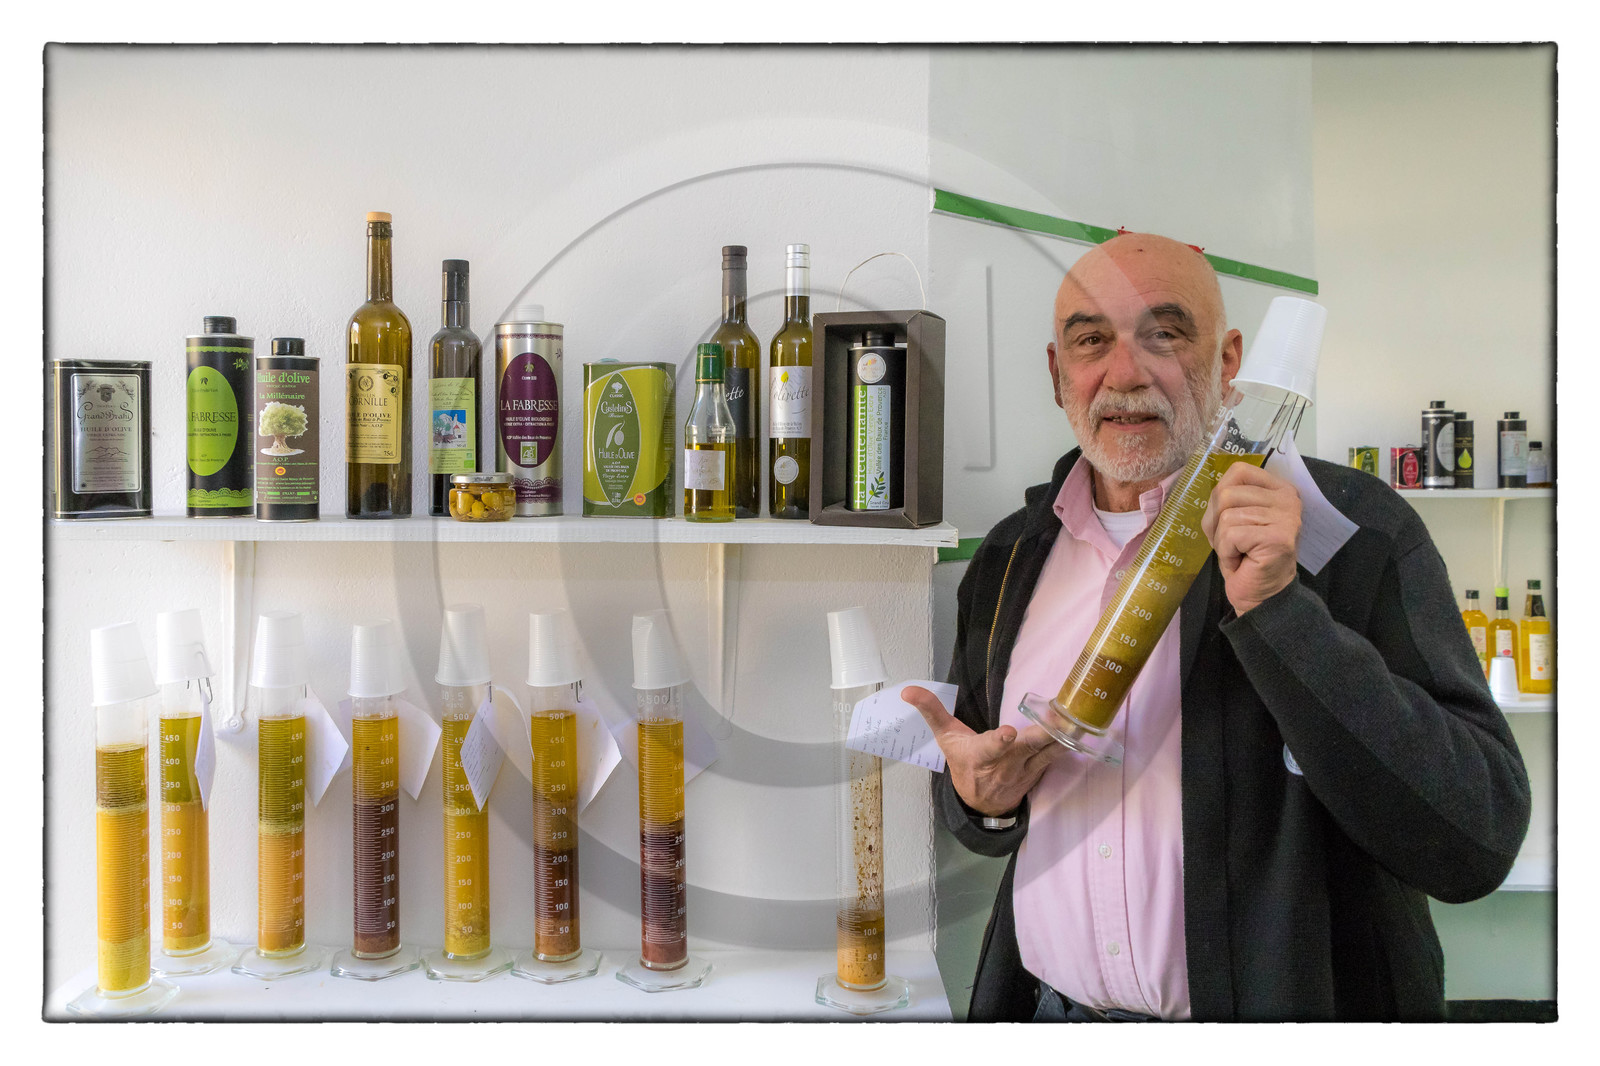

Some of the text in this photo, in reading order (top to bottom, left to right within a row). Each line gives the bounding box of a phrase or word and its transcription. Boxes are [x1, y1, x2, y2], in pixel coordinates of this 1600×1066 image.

[278, 372, 310, 384] d'olive
[266, 392, 305, 400] Millénaire
[500, 399, 558, 412] LA FABRESSE
[191, 411, 237, 423] FABRESSE
[854, 390, 866, 504] la lieutenante
[1224, 440, 1246, 457] 500
[1208, 469, 1224, 482] 45
[1193, 497, 1208, 509] 40
[1177, 524, 1199, 540] 350
[1162, 551, 1183, 567] 300
[1146, 579, 1168, 595] 250
[1132, 605, 1153, 621] 200
[1119, 633, 1138, 647] 150
[1104, 659, 1123, 674] 100
[1093, 687, 1108, 700] 50
[291, 732, 303, 740] 450
[291, 756, 303, 764] 400
[291, 779, 303, 787] 350
[381, 780, 394, 788] 350
[291, 802, 303, 811] 300
[381, 803, 394, 812] 300
[381, 827, 395, 836] 250
[381, 850, 395, 859] 200
[553, 855, 568, 863] 200
[383, 874, 395, 883] 150
[555, 879, 568, 887] 150
[383, 897, 395, 906] 100
[386, 921, 395, 929] 50
[559, 926, 569, 934] 50
[863, 928, 877, 936] 100
[867, 953, 878, 961] 50
